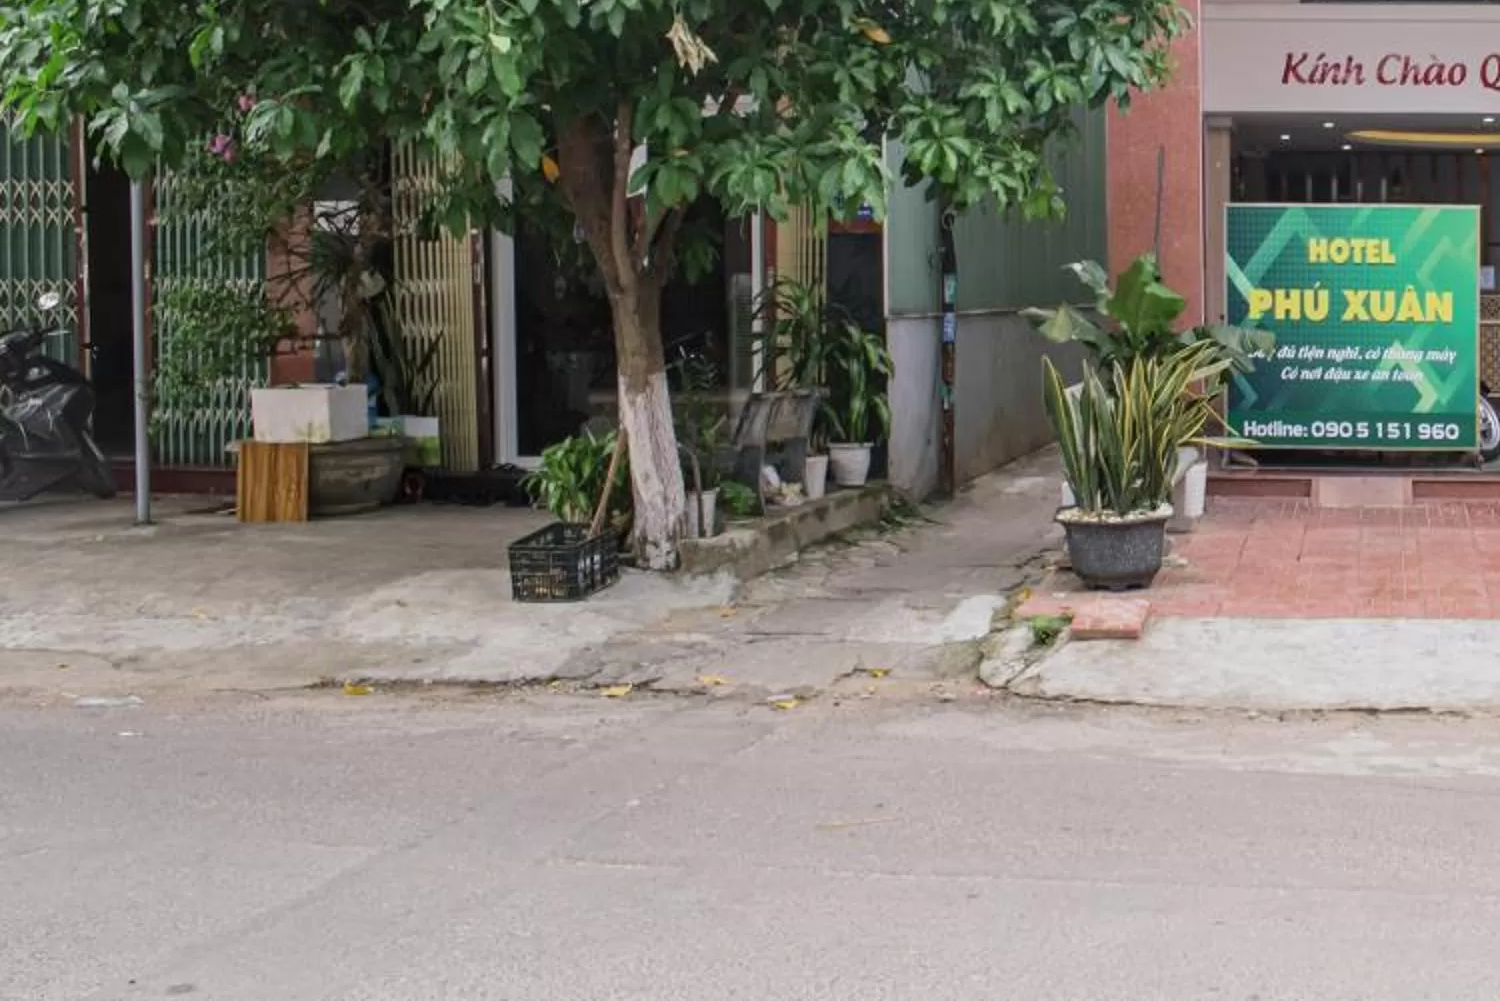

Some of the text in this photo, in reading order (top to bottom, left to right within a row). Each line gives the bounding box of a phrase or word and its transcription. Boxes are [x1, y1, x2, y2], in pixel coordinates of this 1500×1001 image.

[1281, 52, 1366, 86] Kính
[1375, 53, 1468, 87] Chào
[1307, 236, 1396, 265] HOTEL
[1247, 280, 1455, 324] PHÚ XUÂN
[1280, 365, 1298, 381] Có
[1353, 370, 1370, 381] xe
[1243, 420, 1308, 437] Hotline:
[1417, 423, 1460, 440] 960
